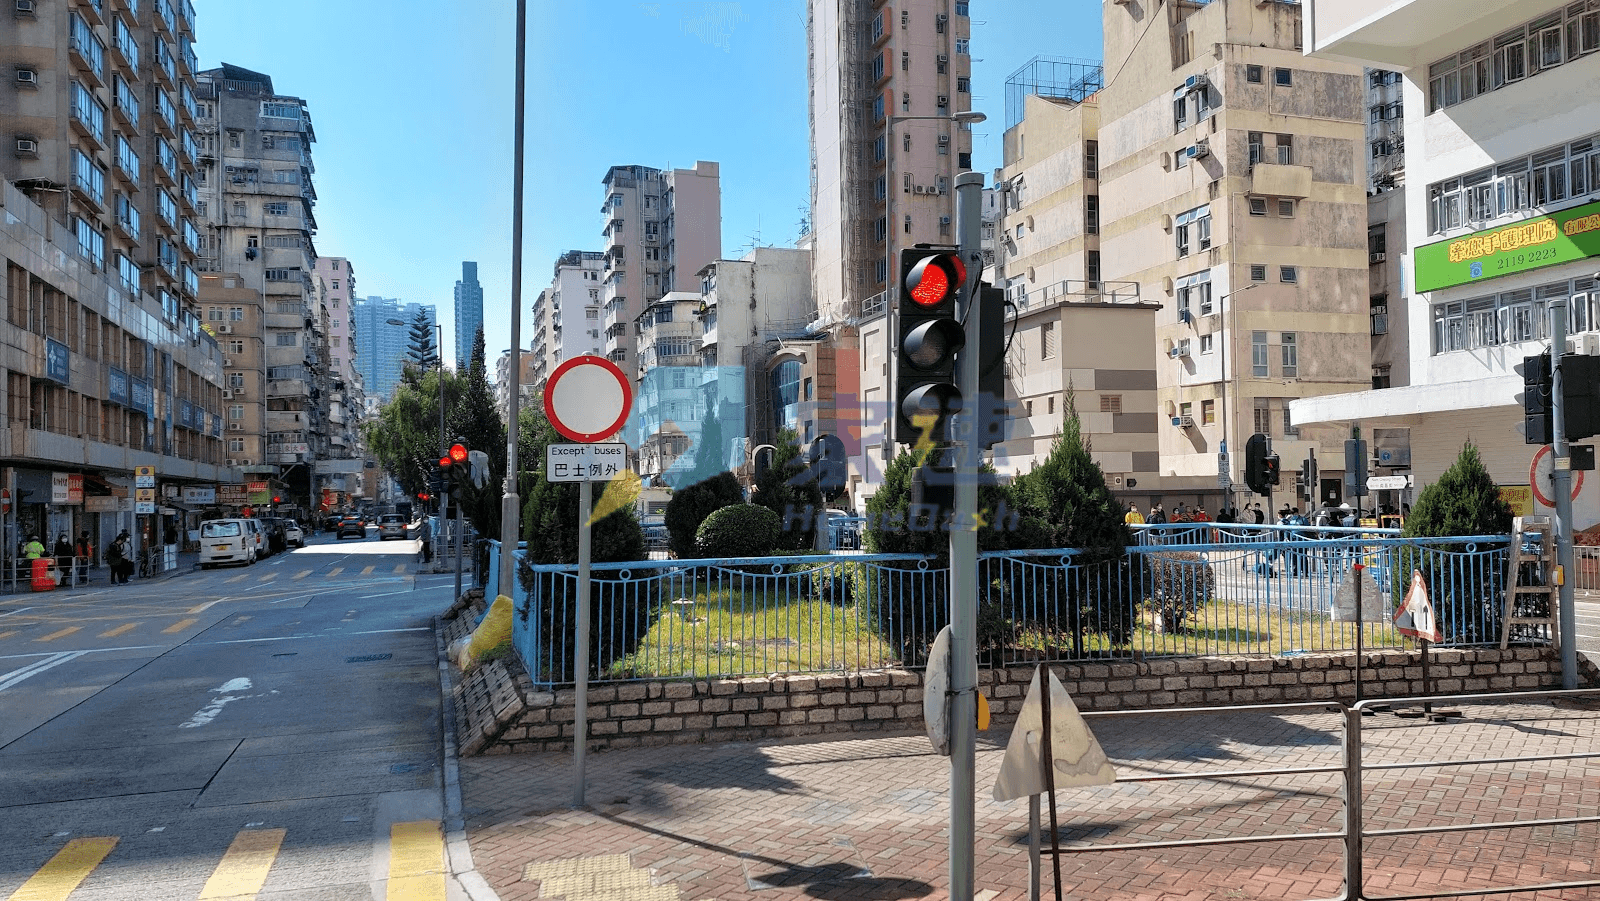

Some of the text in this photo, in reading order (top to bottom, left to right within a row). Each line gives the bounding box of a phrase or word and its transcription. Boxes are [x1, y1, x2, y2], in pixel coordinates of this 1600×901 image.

[1497, 248, 1557, 270] 2119 2223
[551, 446, 622, 457] Except buses
[555, 463, 618, 477] 巴士例外
